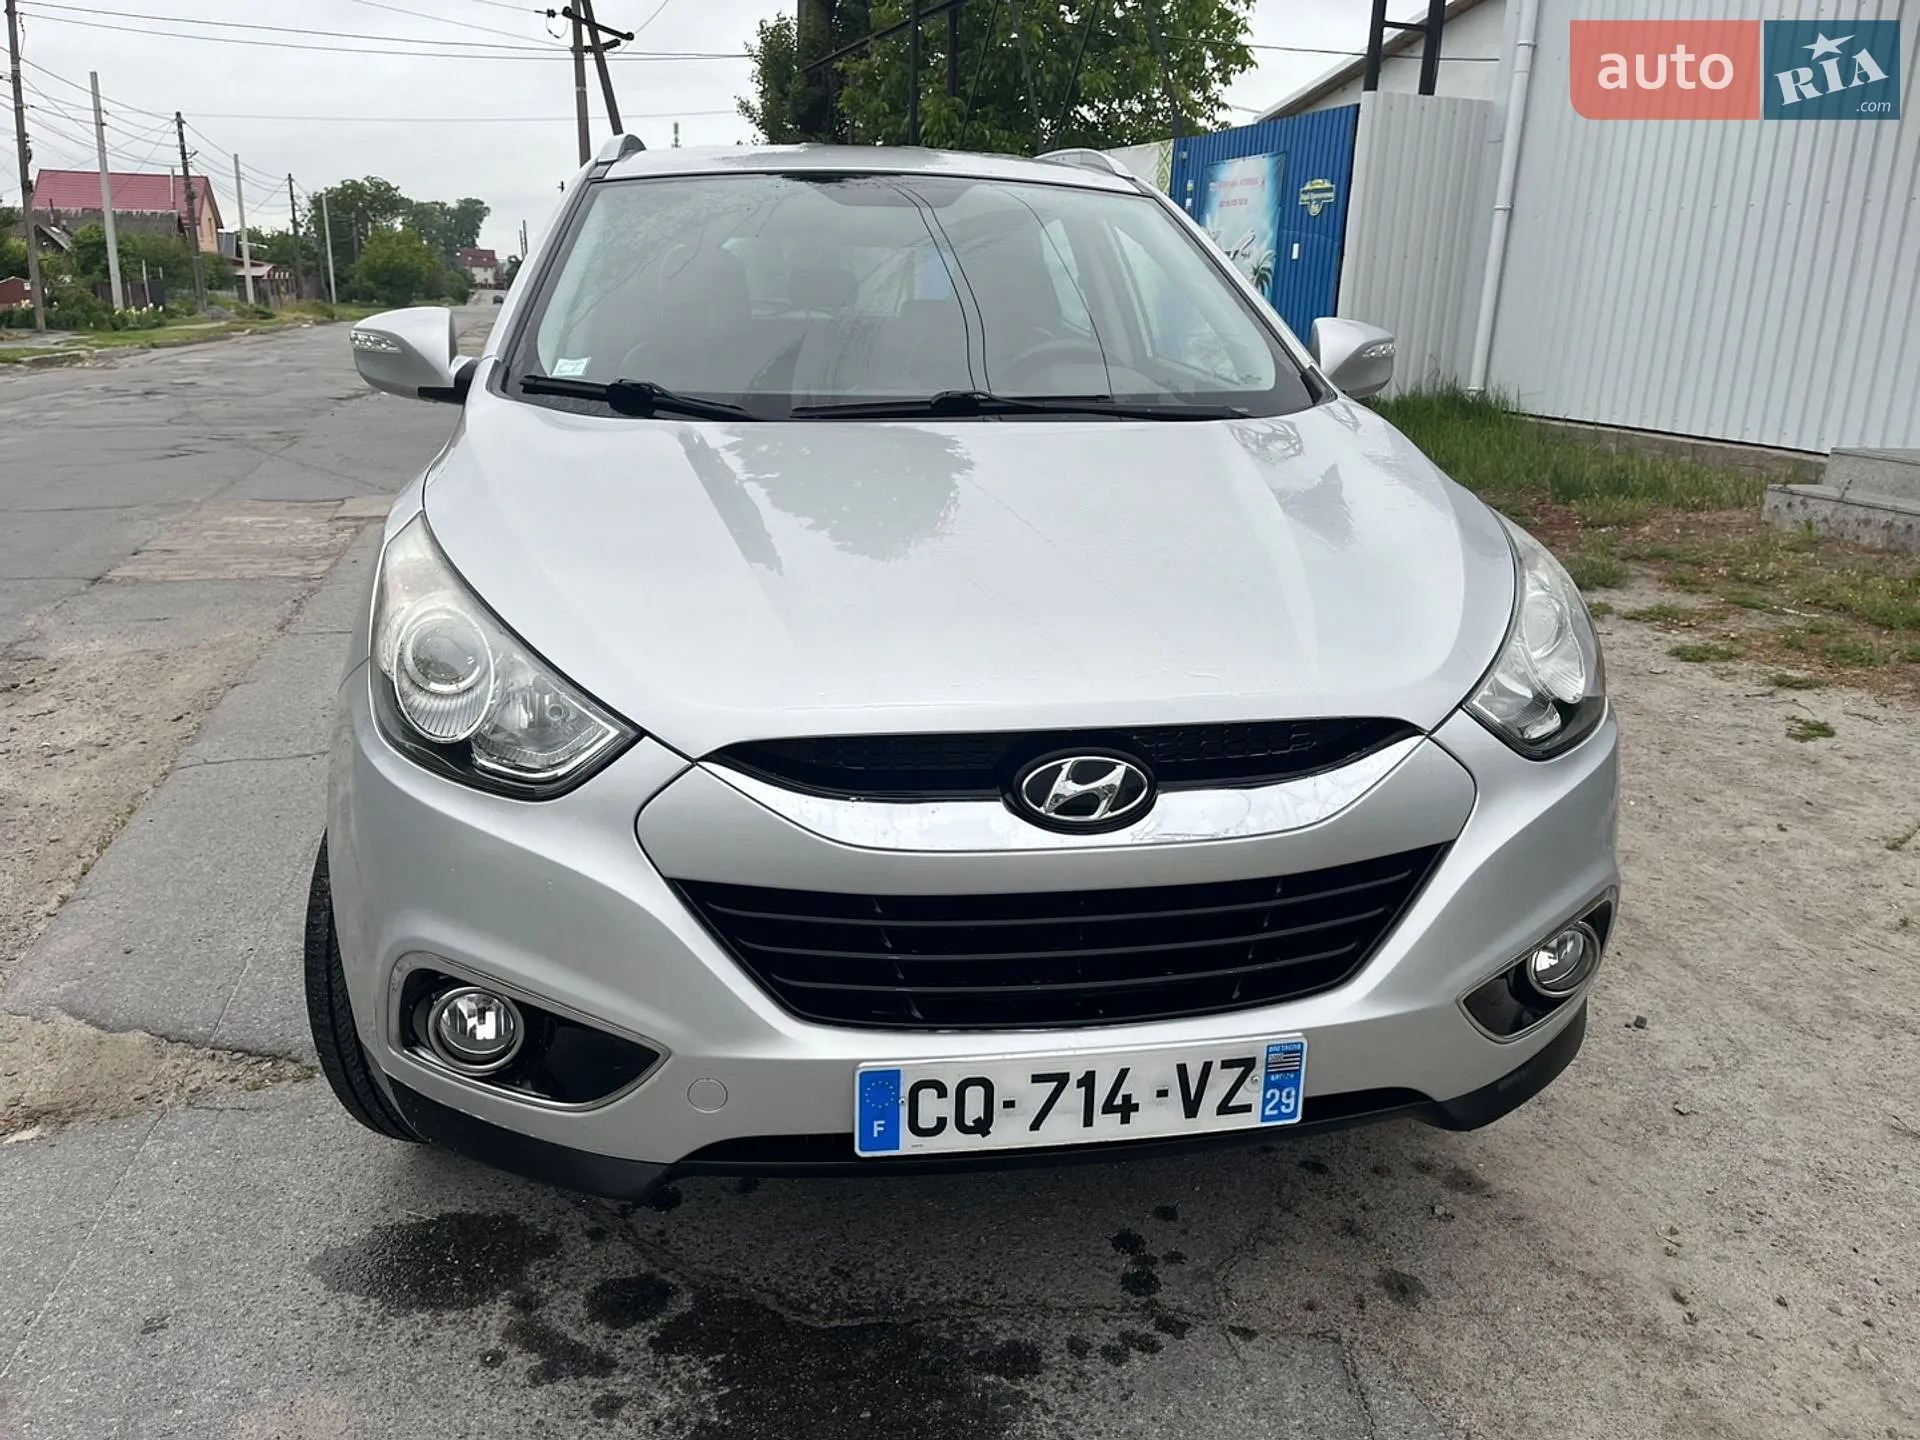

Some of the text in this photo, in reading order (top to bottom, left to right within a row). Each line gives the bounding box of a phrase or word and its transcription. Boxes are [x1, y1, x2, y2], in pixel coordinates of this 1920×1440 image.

[908, 1056, 1257, 1138] CQ-714-VZ
[1264, 1086, 1296, 1116] 29
[873, 1120, 885, 1137] F
